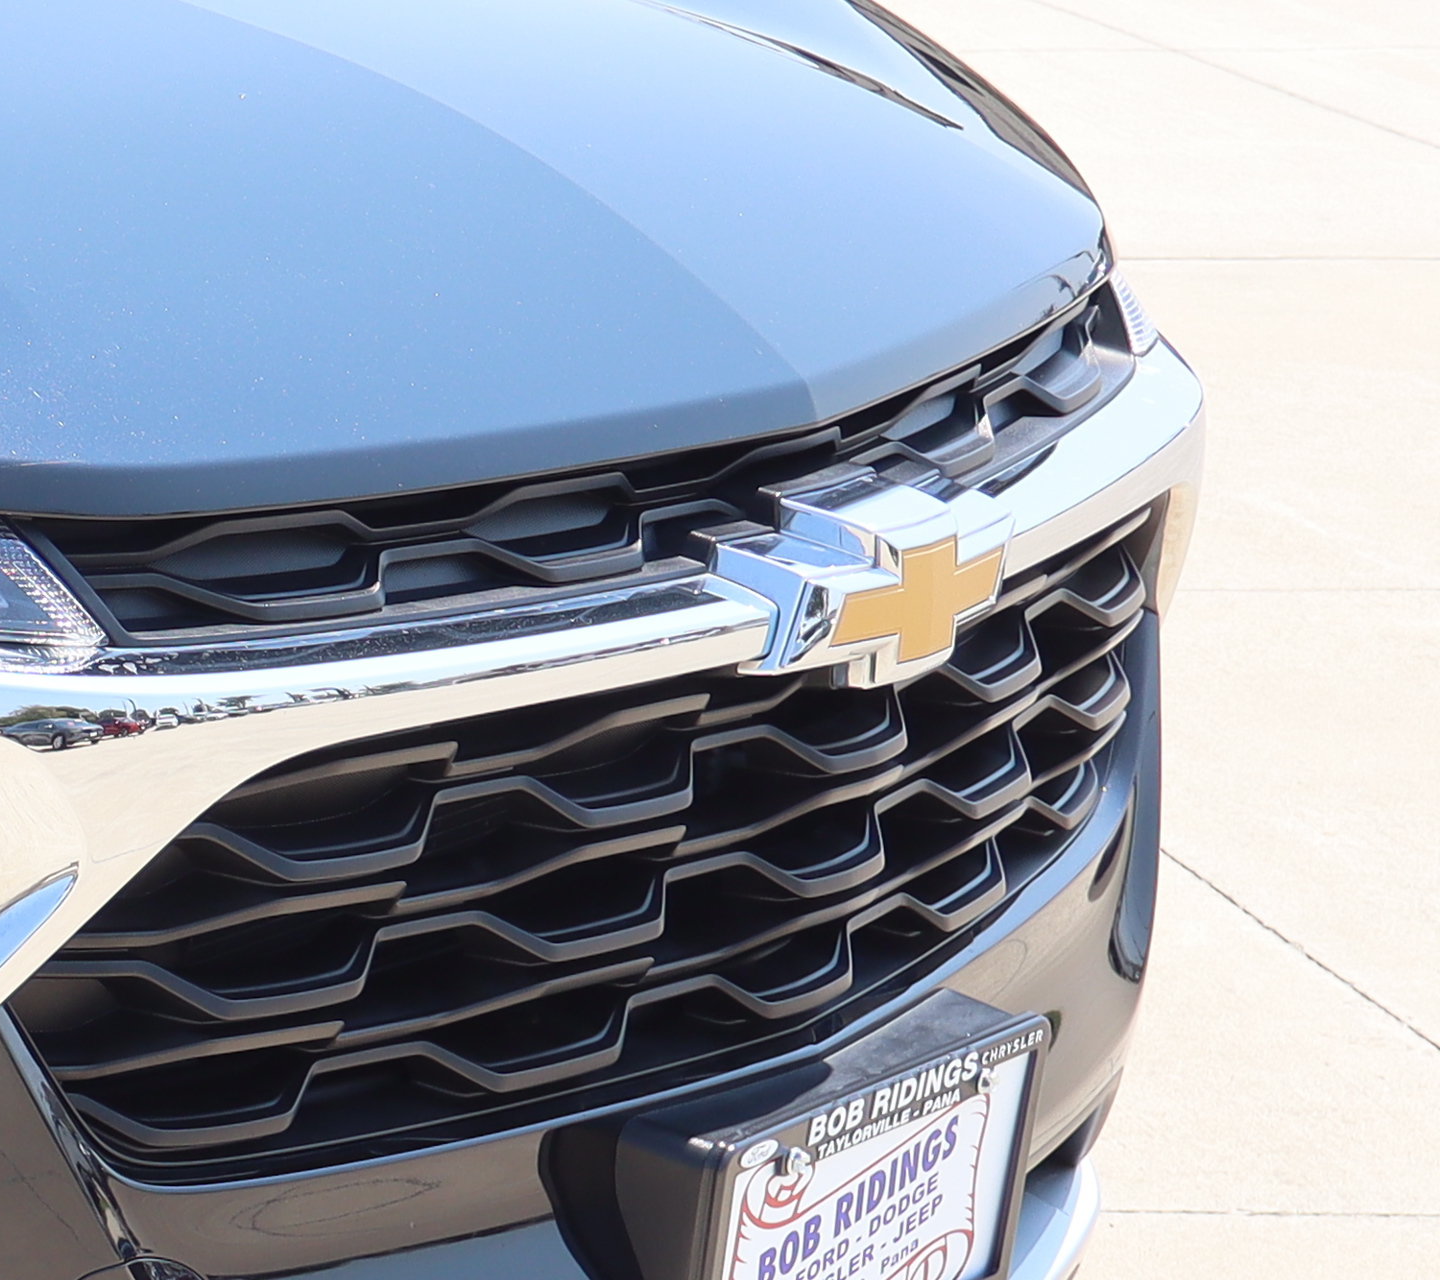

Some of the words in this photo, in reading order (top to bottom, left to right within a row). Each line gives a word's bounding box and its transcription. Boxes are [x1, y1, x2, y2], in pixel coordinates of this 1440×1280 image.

[981, 1029, 1044, 1065] CHRYSLER
[807, 1097, 867, 1147] BOB
[870, 1051, 979, 1119] RIDINGS
[817, 1107, 910, 1160] TAYLORVILLE
[922, 1088, 961, 1115] PANA
[833, 1115, 959, 1238] RIDINGS
[868, 1172, 939, 1238] DODGE
[893, 1193, 943, 1244] JEEP
[880, 1238, 919, 1274] Pana
